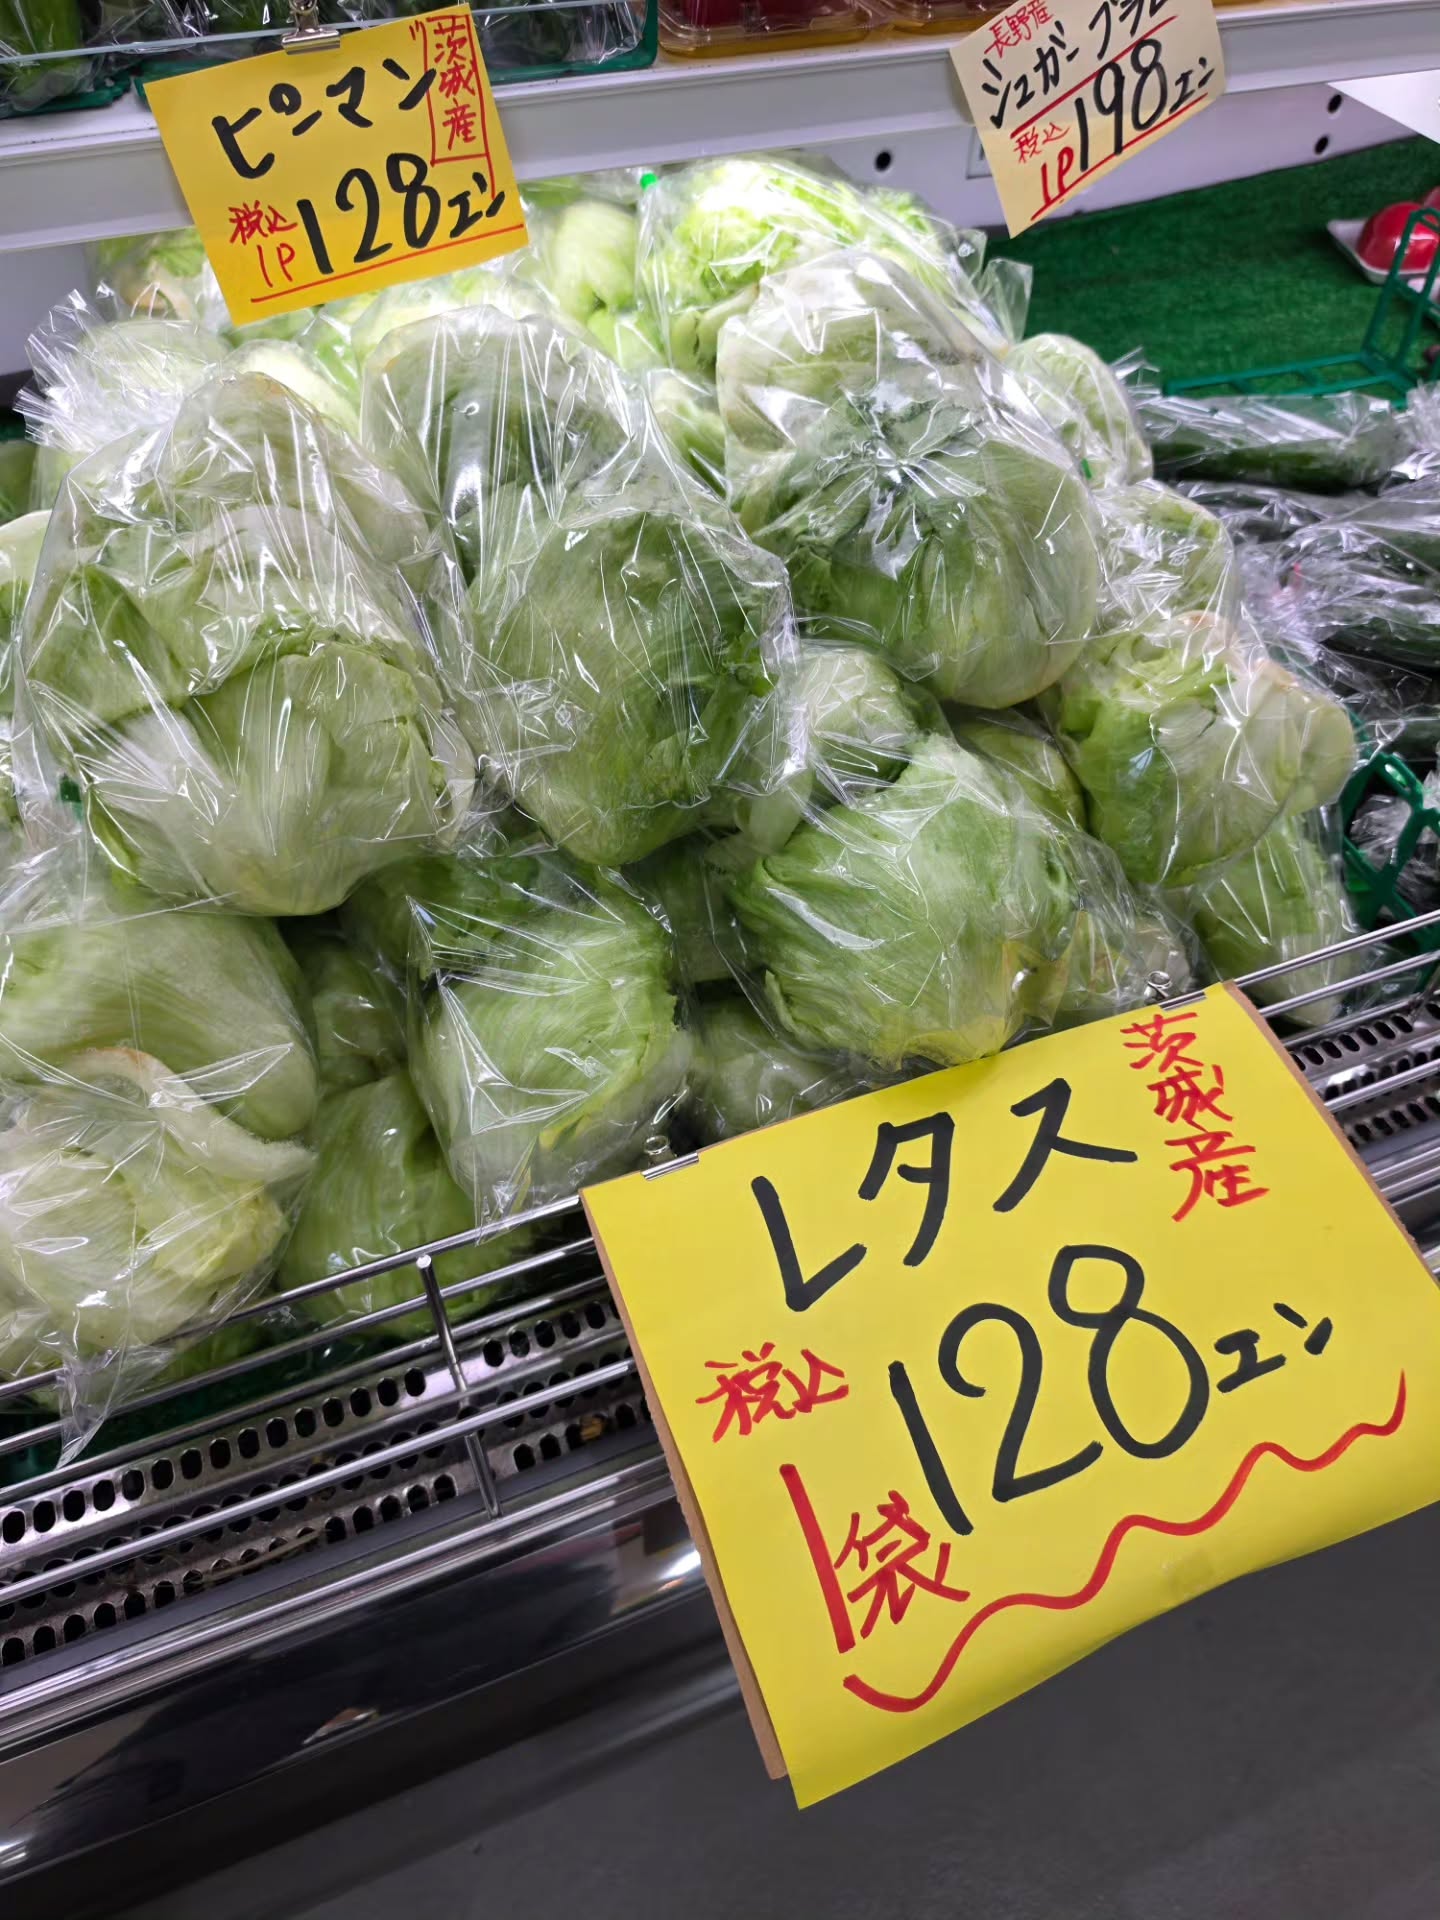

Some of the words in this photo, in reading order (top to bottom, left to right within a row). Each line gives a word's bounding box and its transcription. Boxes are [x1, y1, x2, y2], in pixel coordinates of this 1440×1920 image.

[984, 0, 1054, 58] 長野産
[212, 58, 437, 179] ピーマン
[433, 21, 476, 151] 茨城産
[1013, 121, 1070, 164] 税込
[1041, 146, 1074, 206] 1P
[228, 200, 299, 244] 税込
[257, 243, 296, 288] 1P
[1120, 1011, 1270, 1222] 茨城産
[751, 1078, 1137, 1312] レタス
[695, 1342, 849, 1442] 税込
[779, 1464, 970, 1652] 1袋
